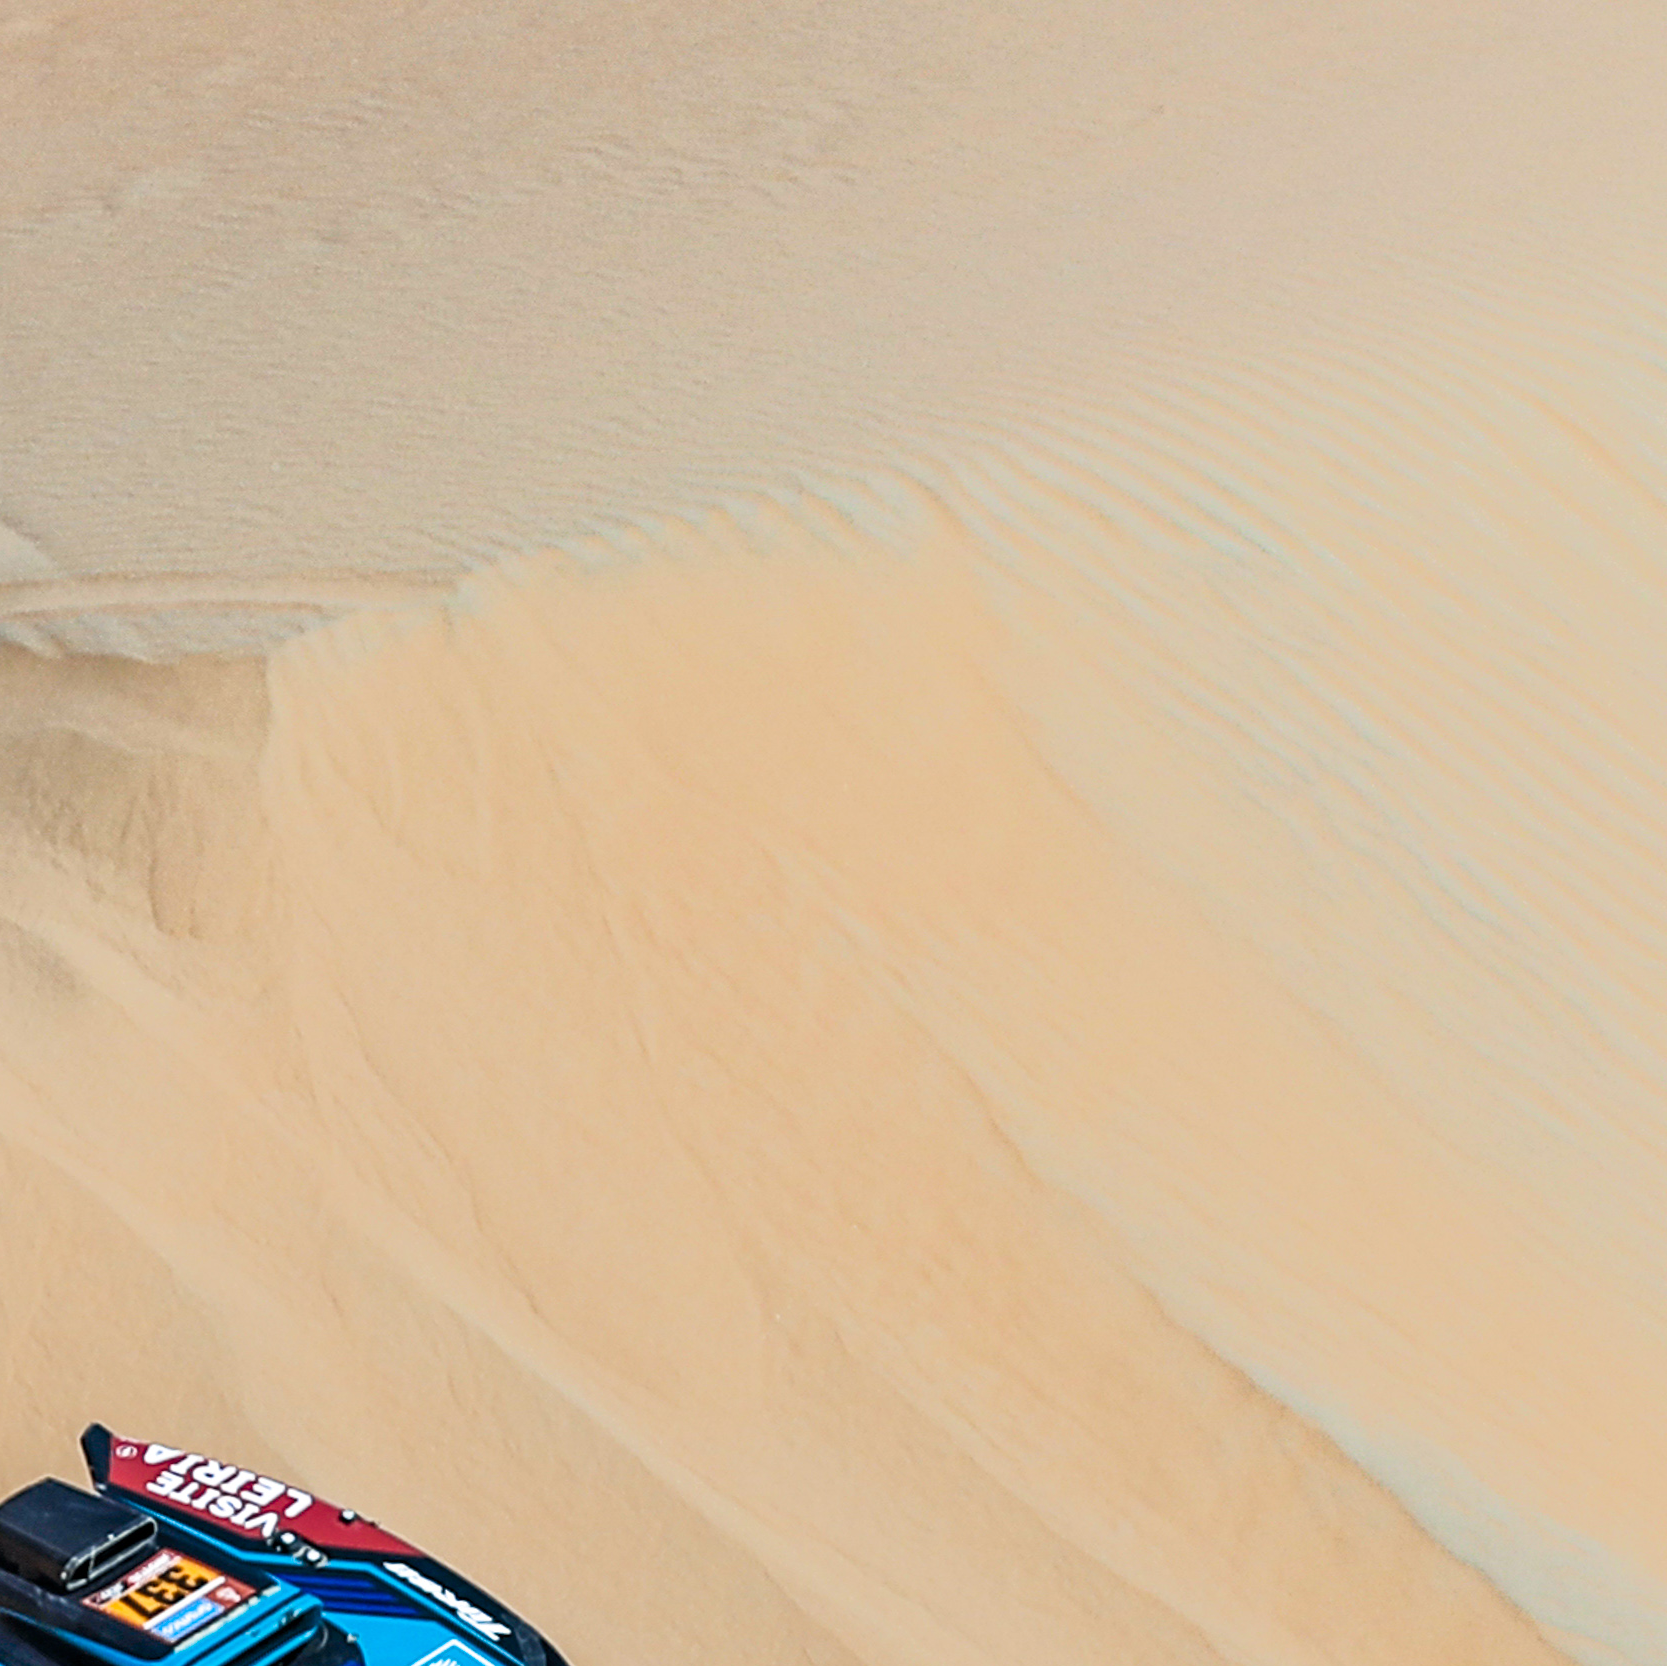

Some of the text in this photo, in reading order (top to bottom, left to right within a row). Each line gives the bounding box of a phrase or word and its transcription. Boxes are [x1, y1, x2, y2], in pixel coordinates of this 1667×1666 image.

[143, 1444, 313, 1518] LEIRIA
[146, 1471, 279, 1538] VISITE
[119, 1565, 207, 1616] 337
